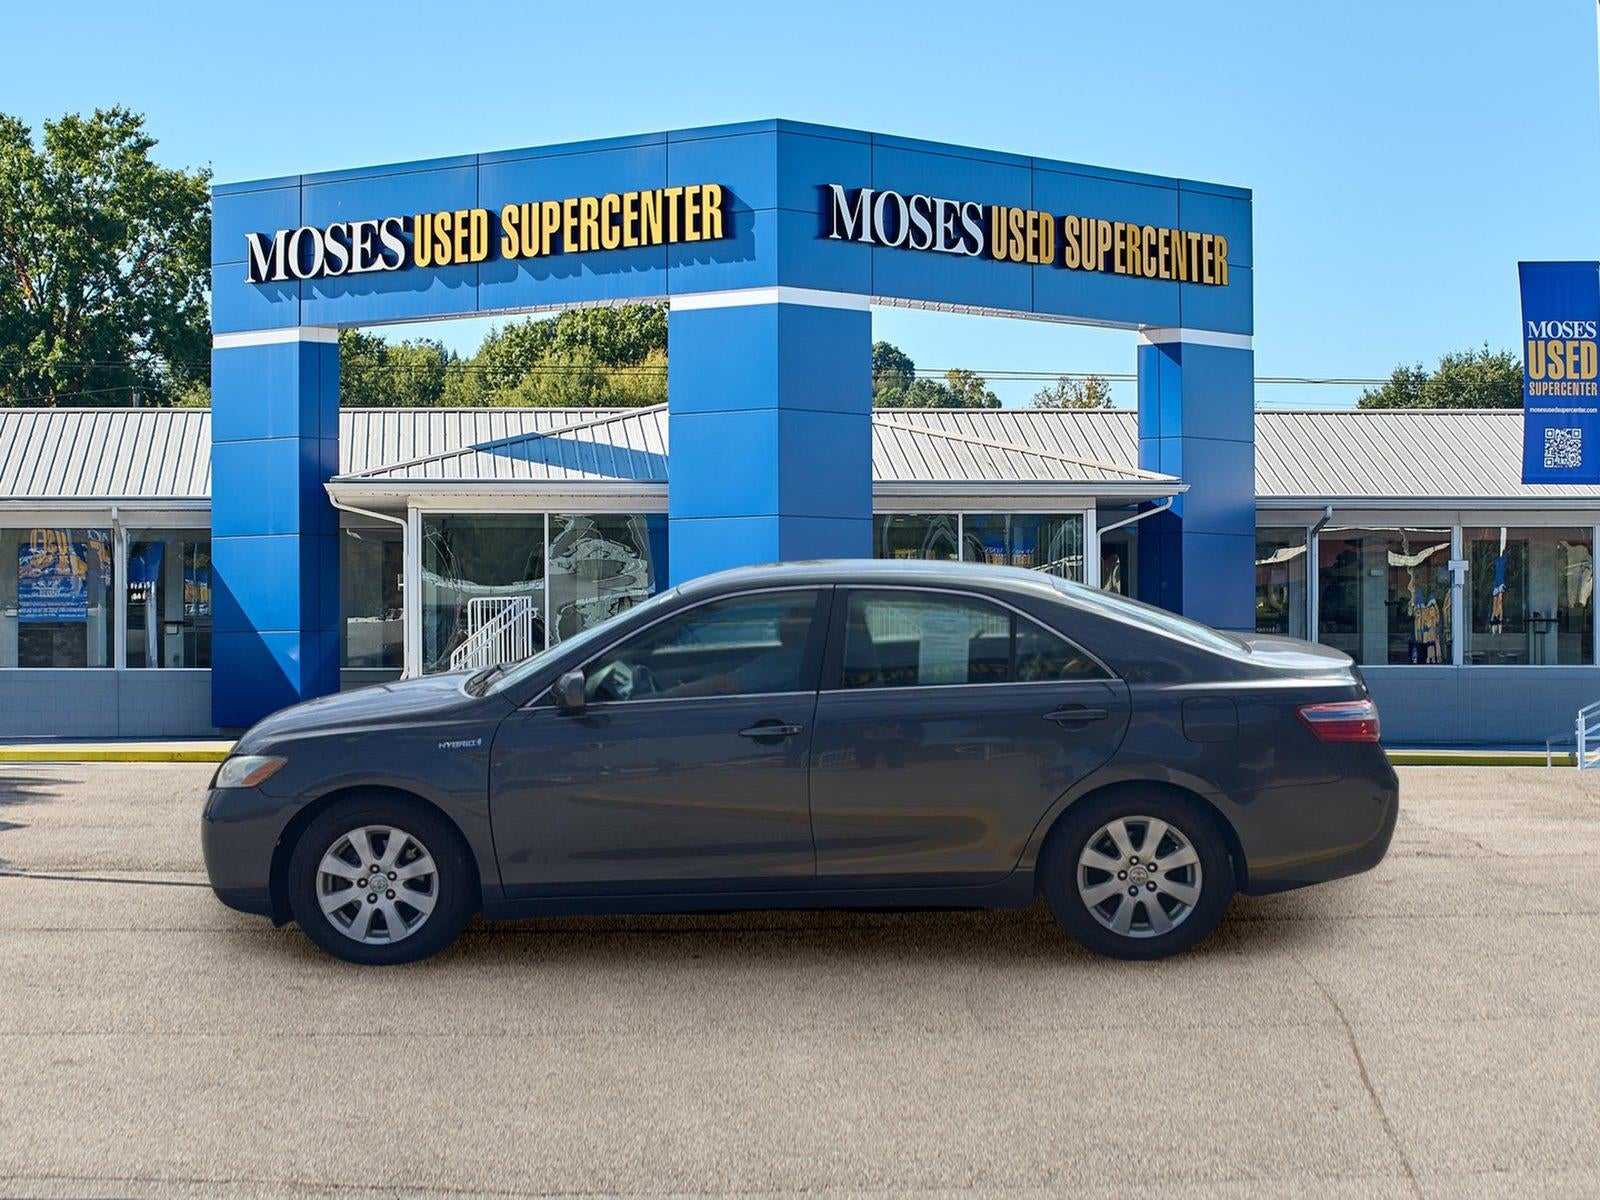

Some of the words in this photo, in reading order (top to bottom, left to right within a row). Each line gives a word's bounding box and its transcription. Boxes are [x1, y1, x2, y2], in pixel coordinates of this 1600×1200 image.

[243, 218, 406, 284] MOSES
[413, 208, 489, 268] USED
[501, 183, 723, 260] SUPERCENTER
[828, 183, 984, 257] MOSES
[991, 204, 1055, 264] USED
[1064, 214, 1229, 286] SUPERCENTER
[1527, 320, 1597, 339] MOSES
[1528, 340, 1598, 380] USED
[1529, 382, 1598, 396] SUPERCENTER
